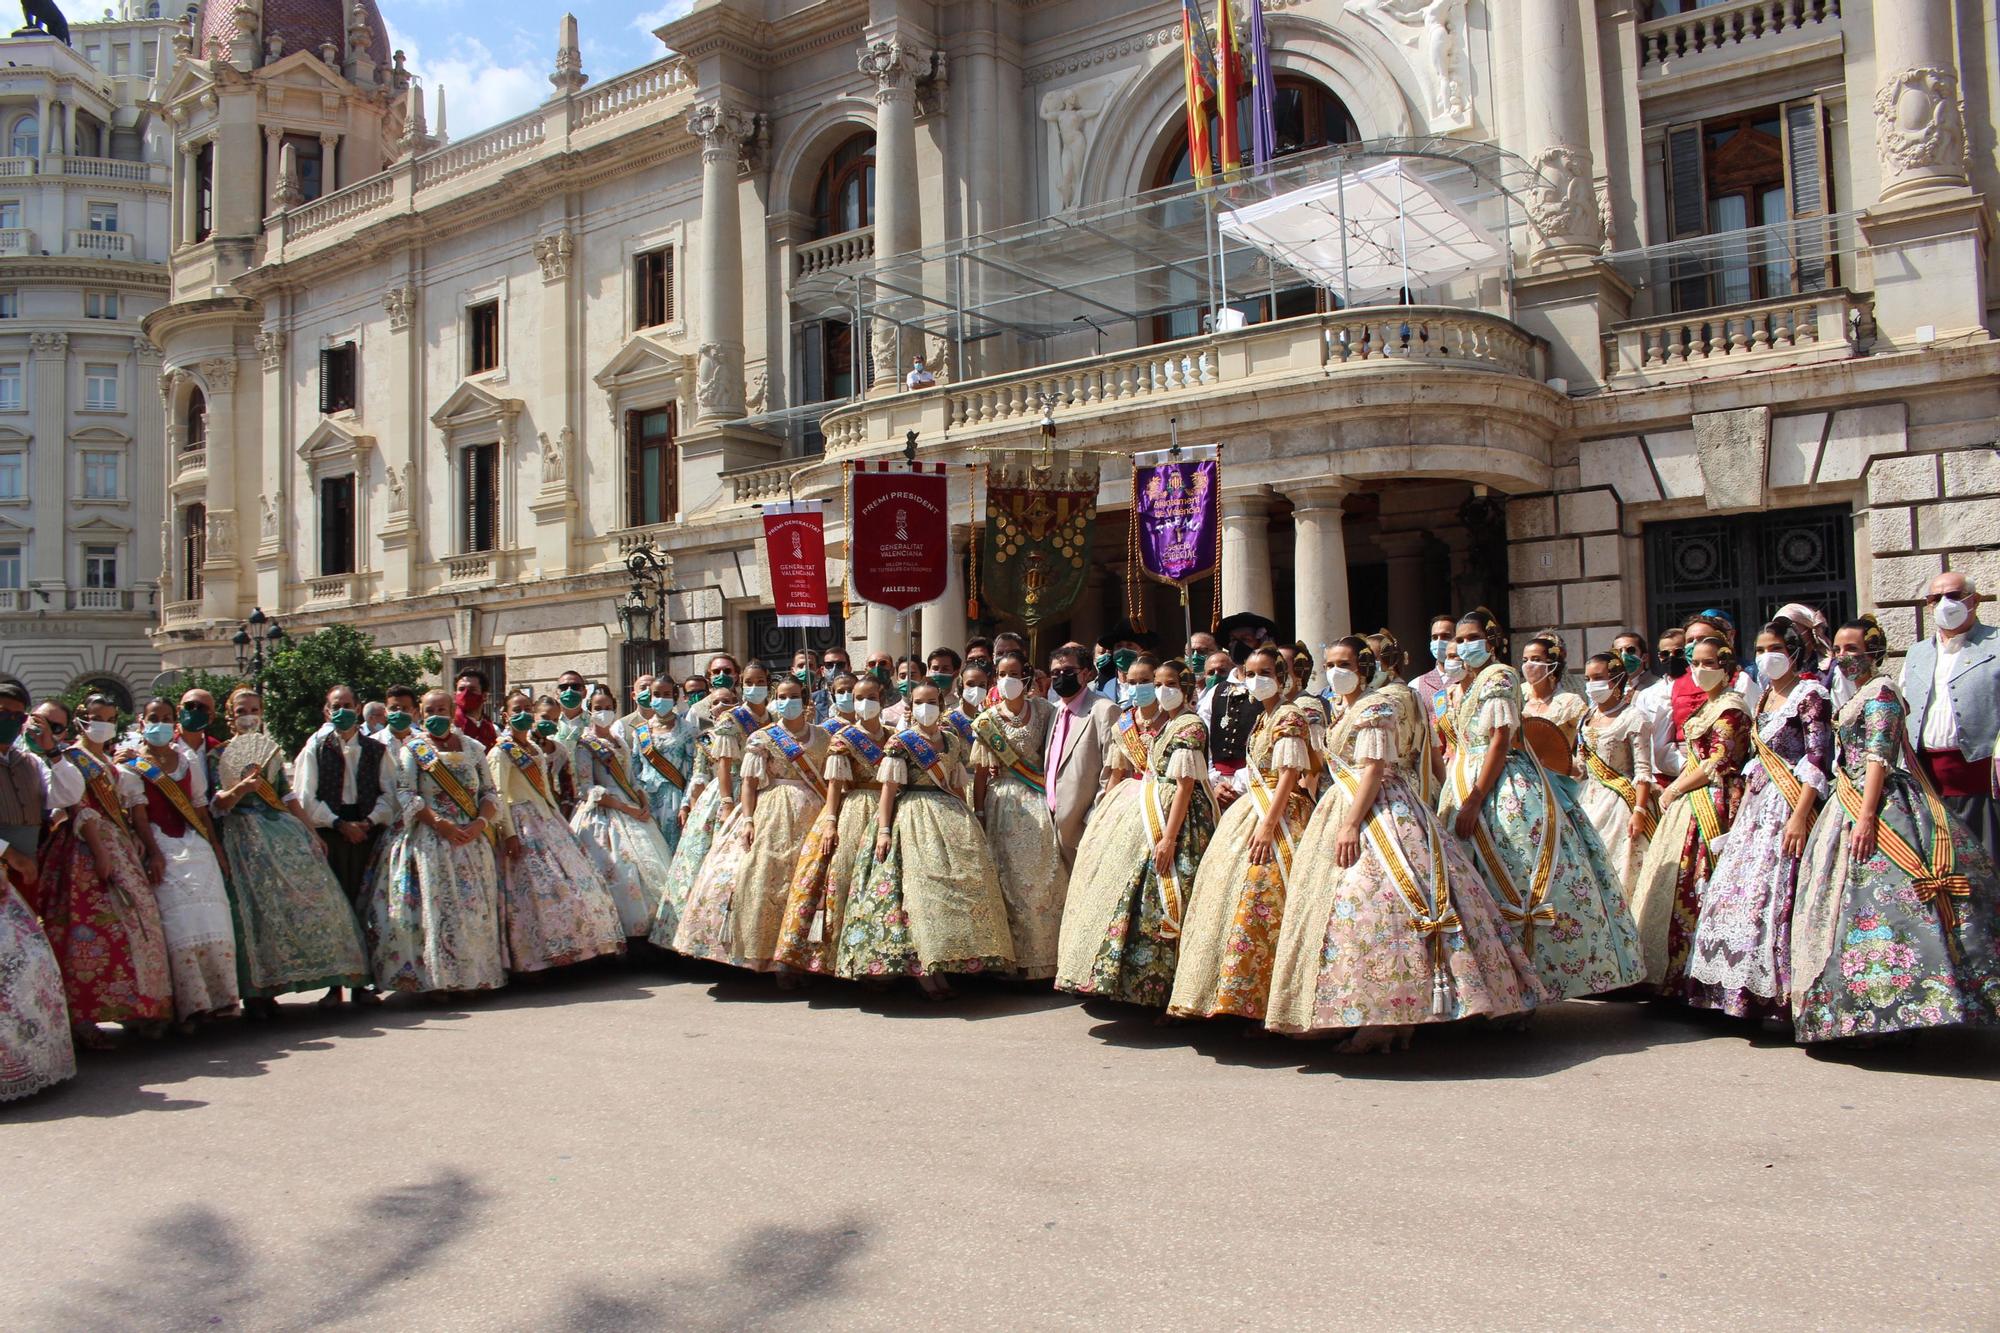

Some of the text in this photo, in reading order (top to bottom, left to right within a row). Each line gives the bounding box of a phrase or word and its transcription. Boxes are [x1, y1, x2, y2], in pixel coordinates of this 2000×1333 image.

[862, 491, 940, 516] PREMI PRESIDENT
[768, 520, 821, 536] PREMI GENERALITAT
